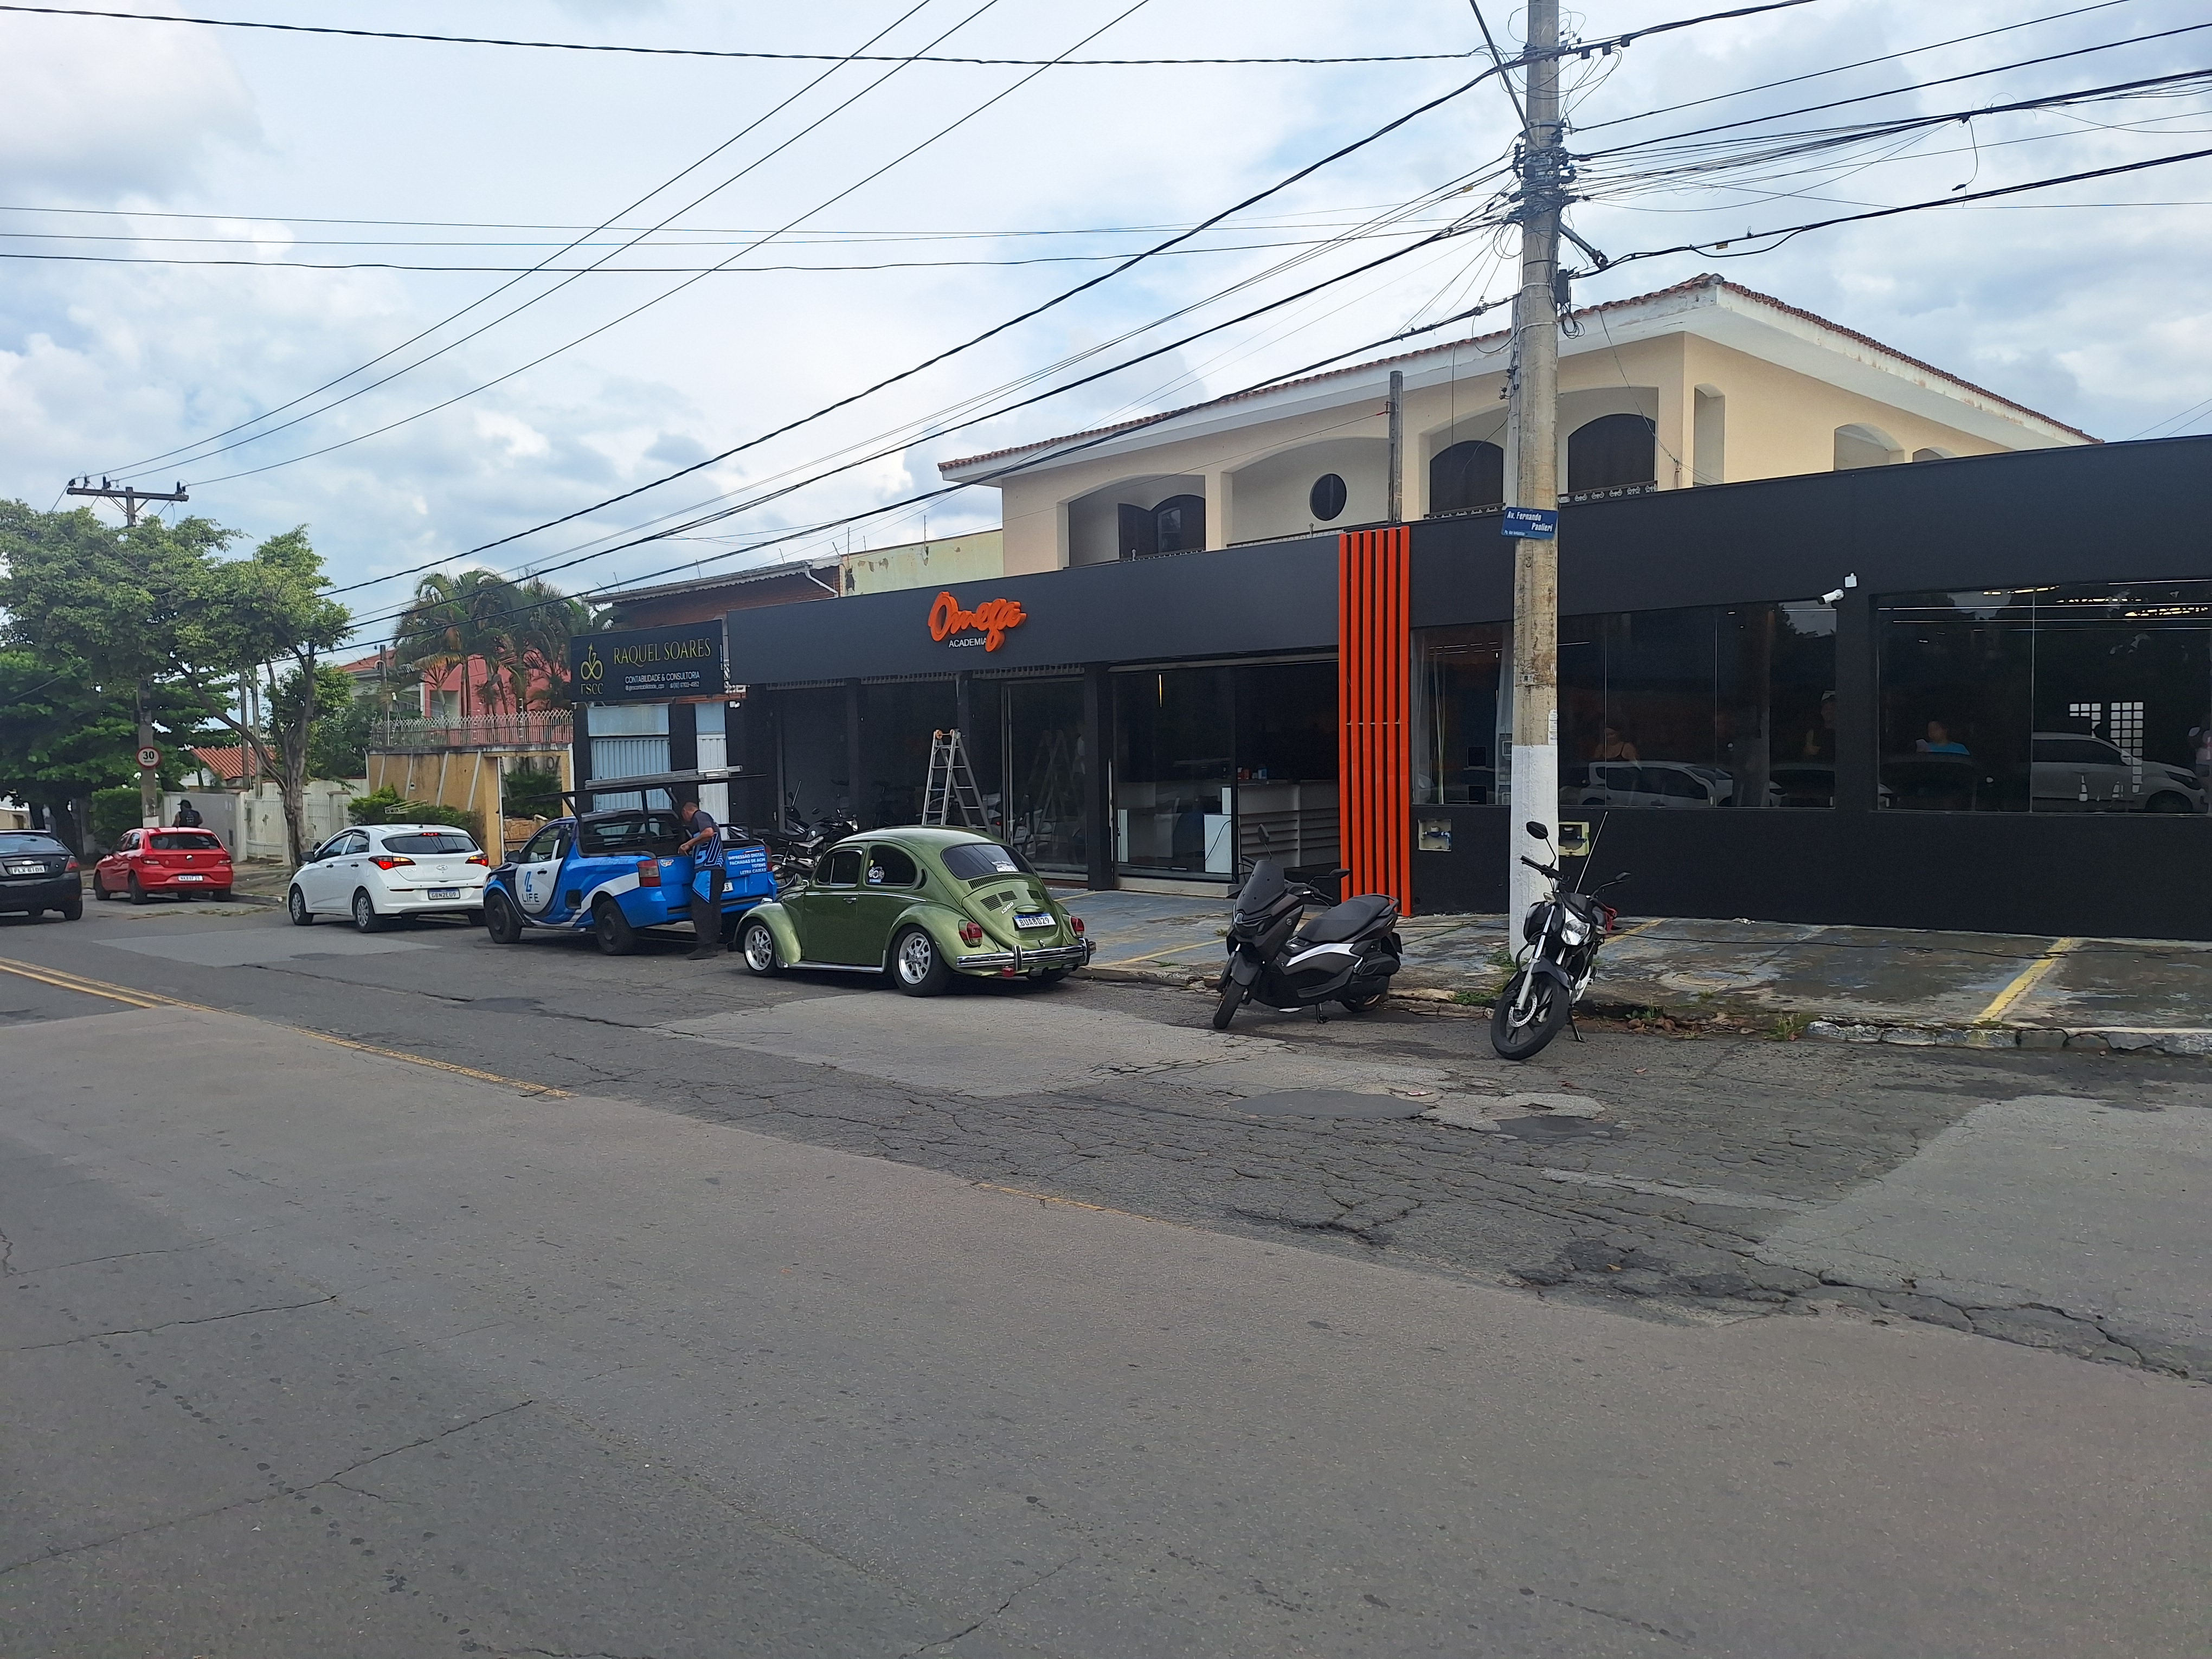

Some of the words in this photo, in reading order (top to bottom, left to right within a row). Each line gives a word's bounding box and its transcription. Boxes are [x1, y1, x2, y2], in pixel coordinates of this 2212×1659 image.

[1516, 512, 1541, 521] Fernando
[1531, 522, 1553, 532] Paolieri
[928, 591, 1027, 652] Omega
[948, 637, 987, 648] ACADEMIA
[613, 644, 661, 667] RAQUEL
[664, 638, 711, 660] SOARES
[625, 674, 661, 684] CONTABILIDADE
[666, 671, 700, 681] CONSULTORIA
[143, 751, 155, 760] 30
[522, 893, 539, 903] LIFE
[1019, 917, 1050, 927] BUA8D29
